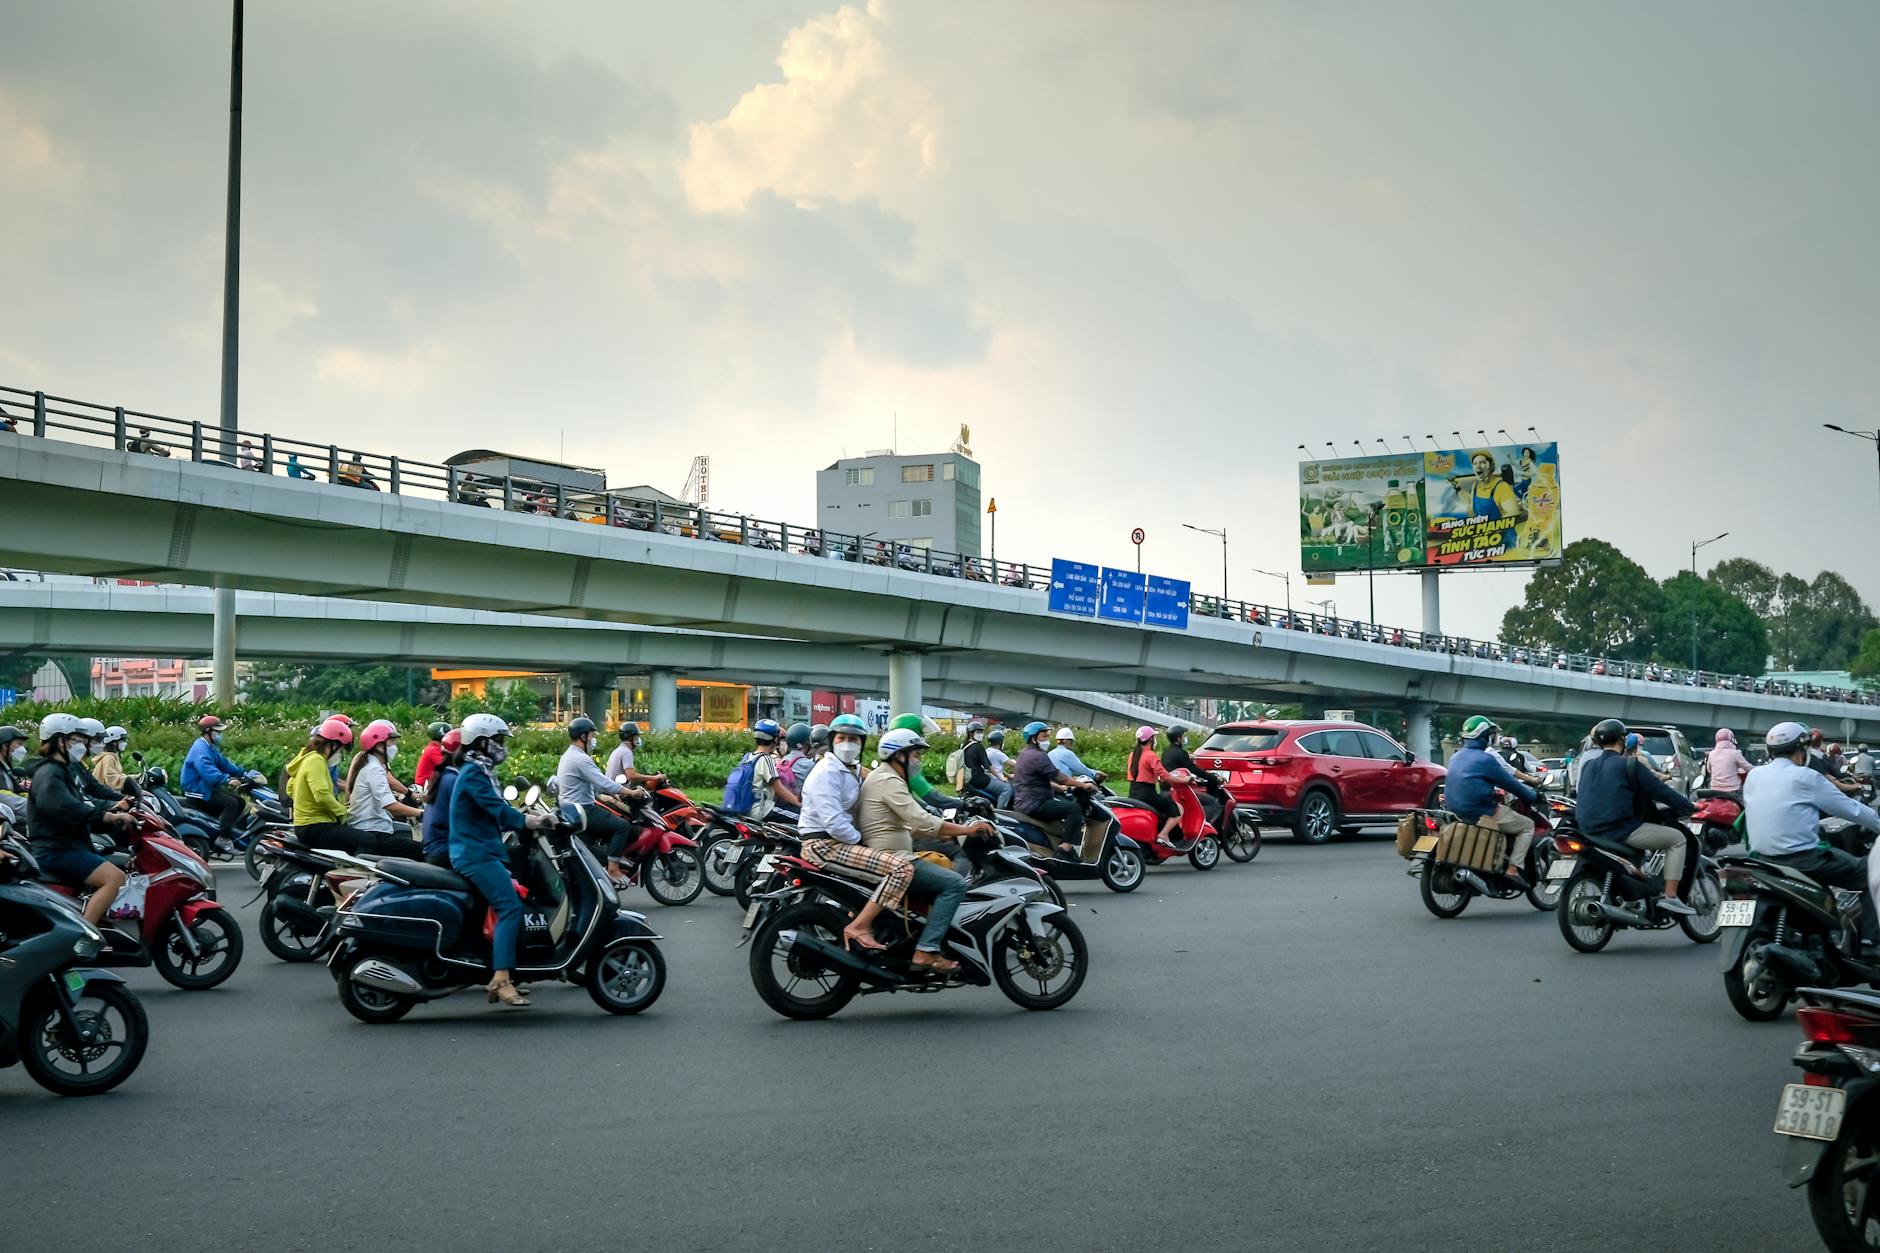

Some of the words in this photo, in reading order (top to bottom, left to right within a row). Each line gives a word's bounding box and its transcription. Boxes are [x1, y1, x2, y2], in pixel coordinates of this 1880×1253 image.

[1451, 524, 1475, 539] SỨC
[1476, 516, 1516, 535] MẠNH
[1464, 549, 1485, 561] TỨC
[710, 694, 735, 709] 100%
[1725, 902, 1750, 913] 59-C1
[1789, 1088, 1834, 1112] 59-S1
